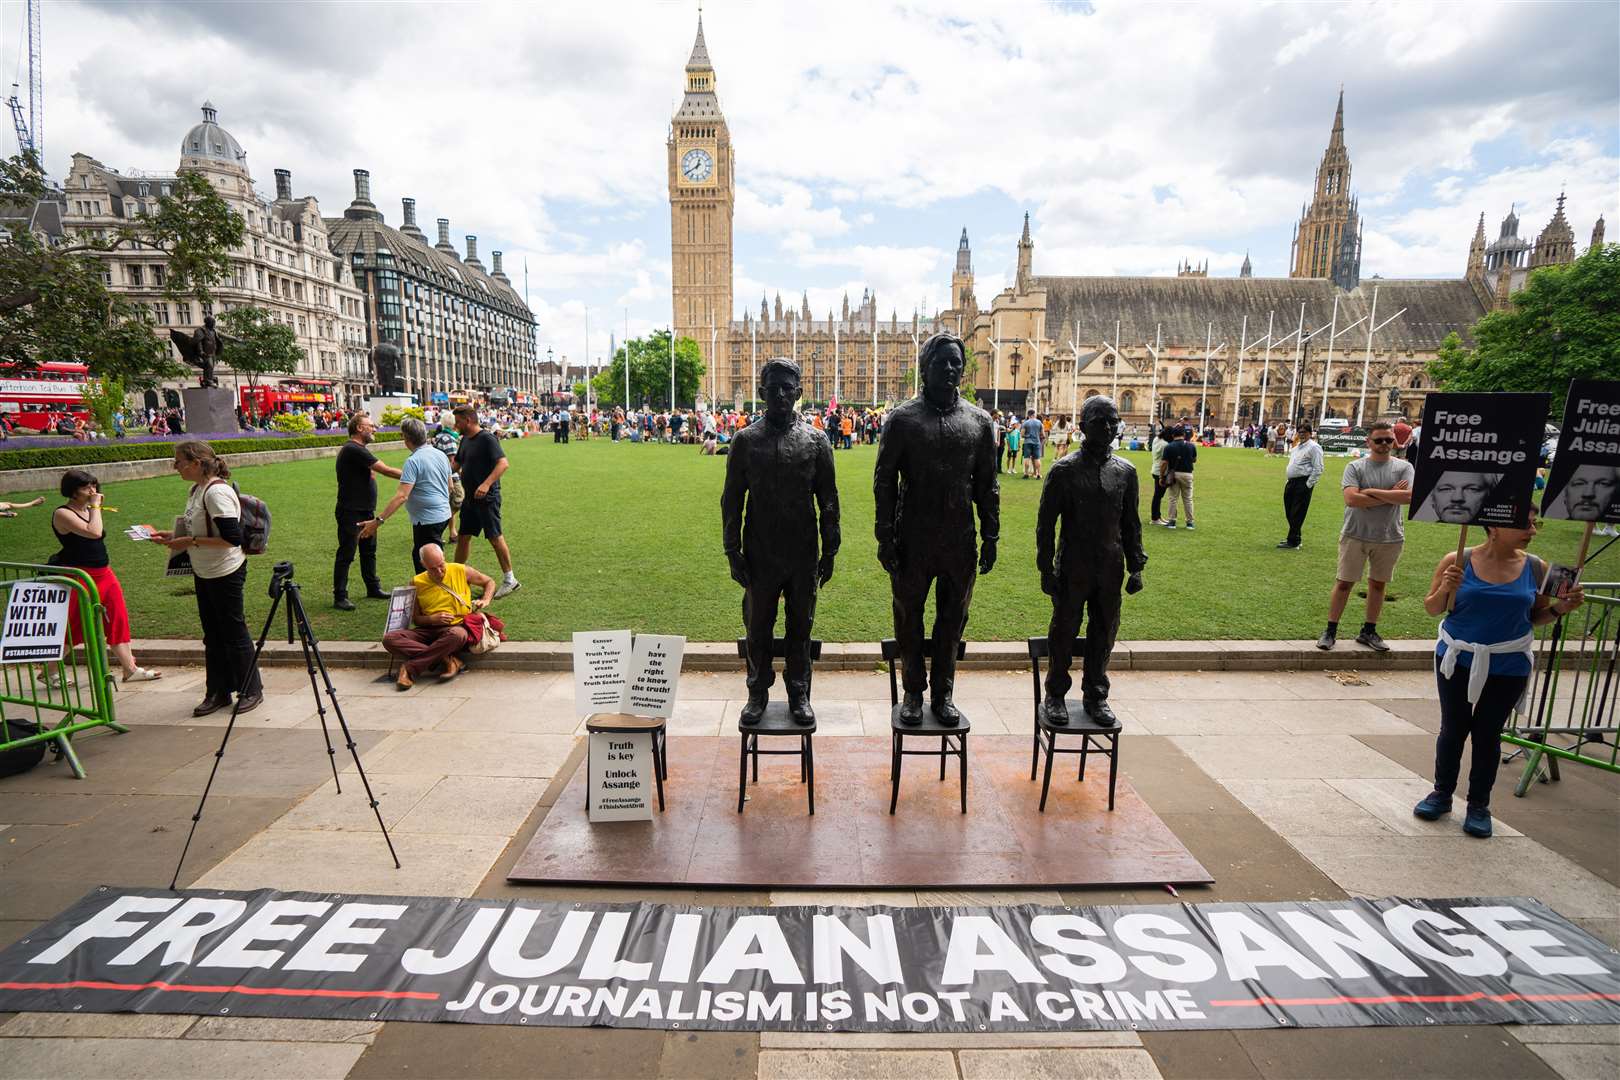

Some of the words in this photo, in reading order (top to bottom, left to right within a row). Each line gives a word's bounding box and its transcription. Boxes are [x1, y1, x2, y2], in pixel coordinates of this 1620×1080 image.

[1434, 411, 1482, 425] Free
[1432, 429, 1498, 444] Julian
[1430, 446, 1526, 465] Assange
[13, 588, 19, 603] I
[23, 588, 67, 603] STAND
[10, 606, 47, 620] WITH
[5, 622, 57, 637] JULIAN
[648, 650, 667, 658] have
[643, 668, 664, 676] right
[646, 686, 670, 694] truth!
[608, 741, 634, 750] Truth
[607, 752, 616, 760] is
[619, 752, 635, 761] key
[605, 769, 637, 779] Unlock
[602, 780, 641, 790] Assange
[27, 896, 405, 972] FREE
[401, 907, 906, 985] JULIAN
[941, 903, 1611, 986] ASSANGE
[446, 981, 795, 1023] JOURNALISM
[805, 991, 852, 1022] IS
[866, 989, 971, 1022] NOT
[988, 991, 1028, 1021] A
[1036, 988, 1207, 1022] CRIME
